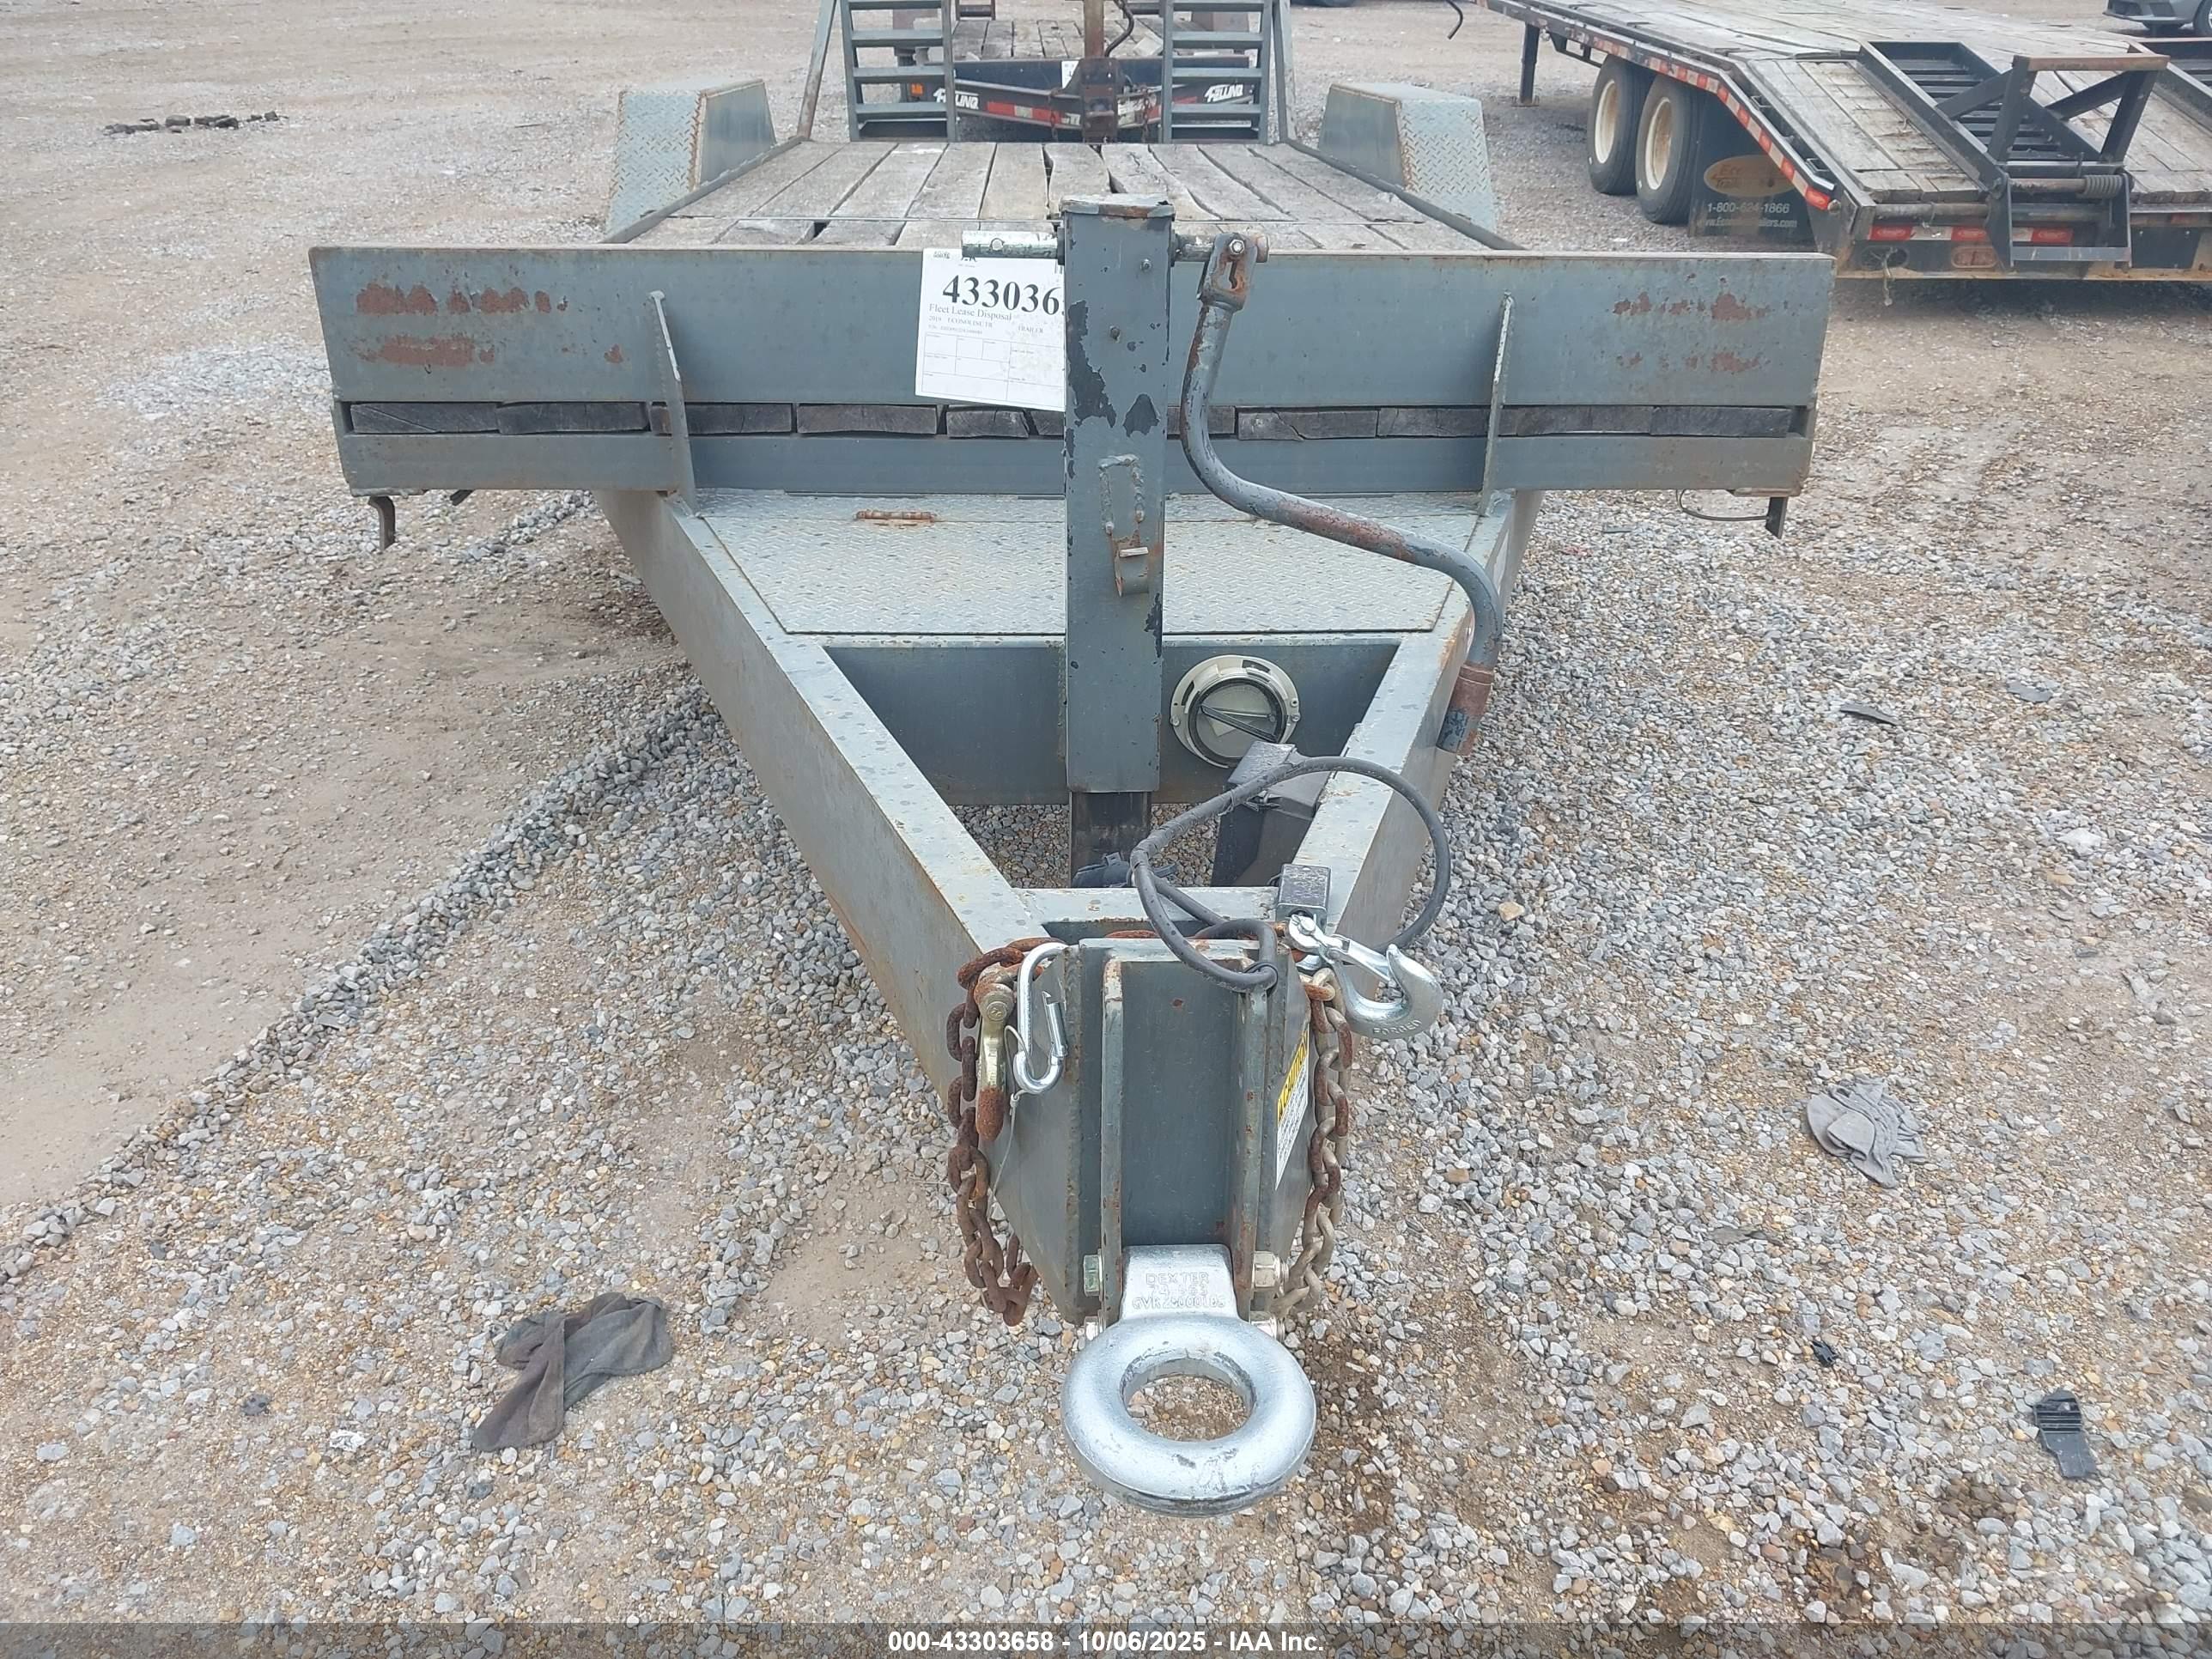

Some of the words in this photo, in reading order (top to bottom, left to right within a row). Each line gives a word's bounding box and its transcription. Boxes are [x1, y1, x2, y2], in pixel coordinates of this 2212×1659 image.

[942, 275, 1065, 316] 433036
[928, 303, 950, 314] Fleet
[951, 305, 975, 317] Lease
[977, 308, 1012, 321] Disposal
[1146, 1272, 1210, 1285] DEXTER
